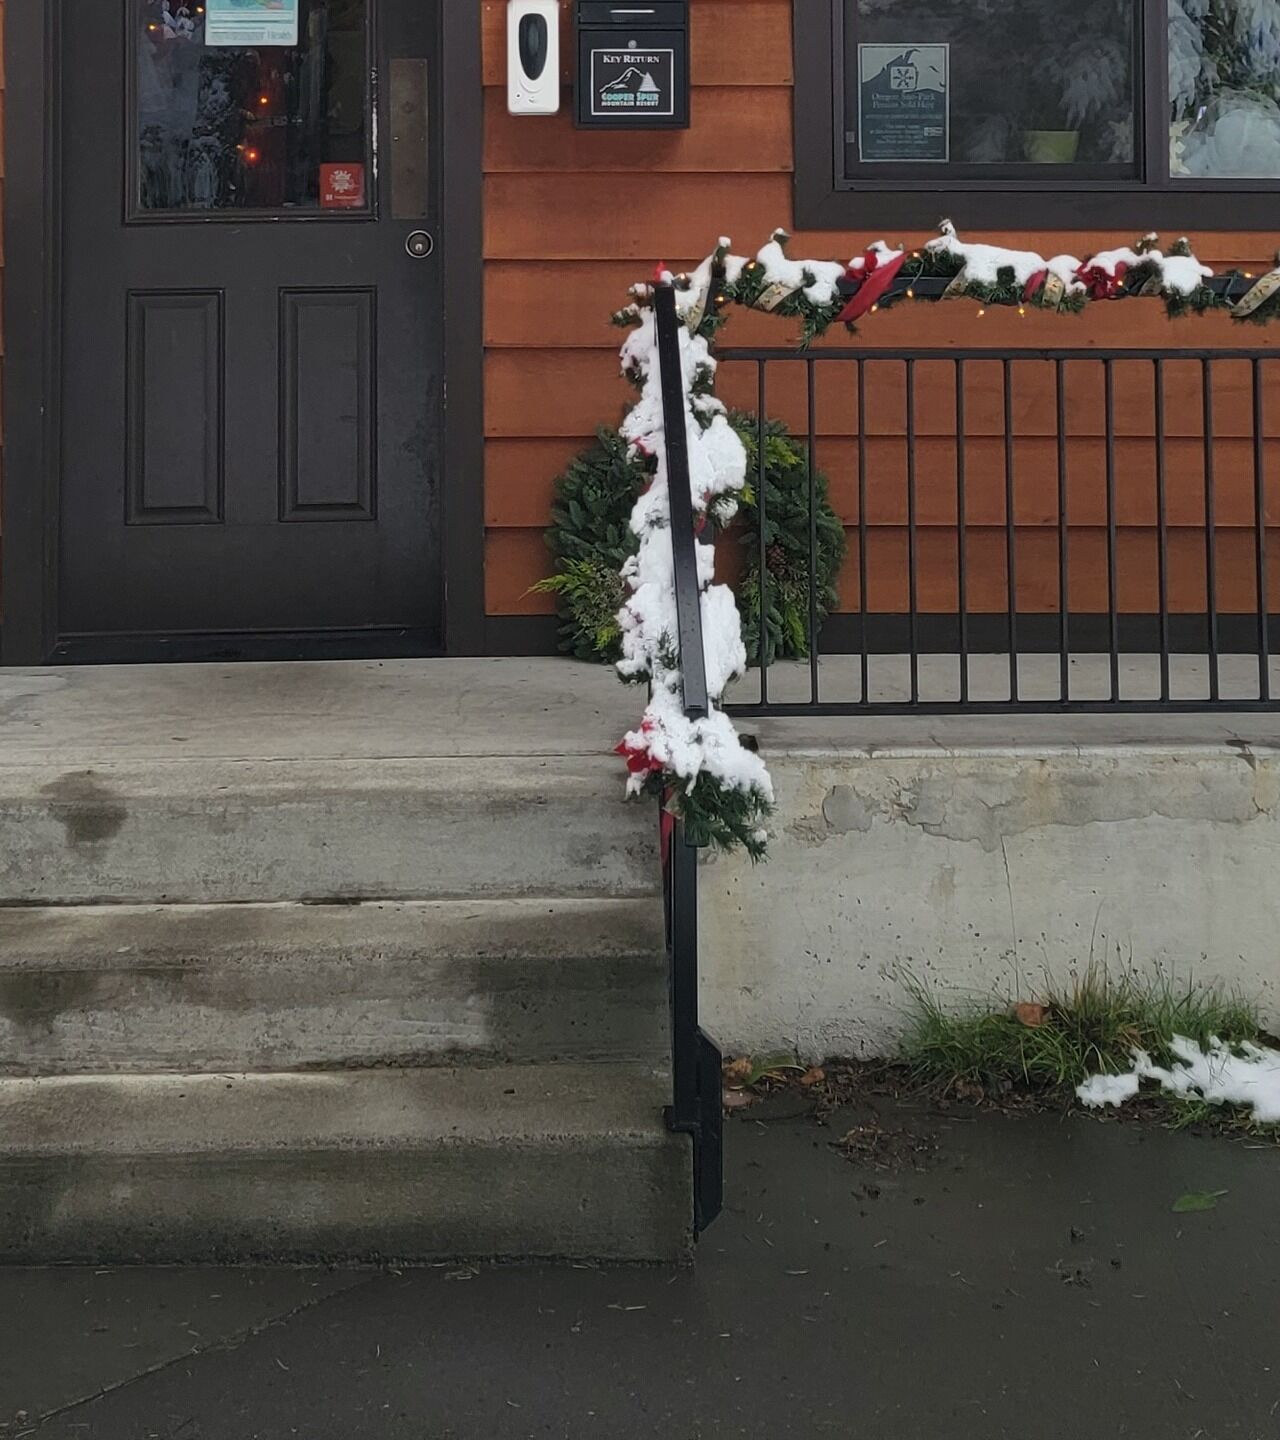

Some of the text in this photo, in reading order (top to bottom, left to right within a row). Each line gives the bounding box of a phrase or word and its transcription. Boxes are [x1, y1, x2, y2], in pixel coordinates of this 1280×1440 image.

[603, 55, 660, 63] KEY RETURN
[601, 93, 635, 101] COOPER
